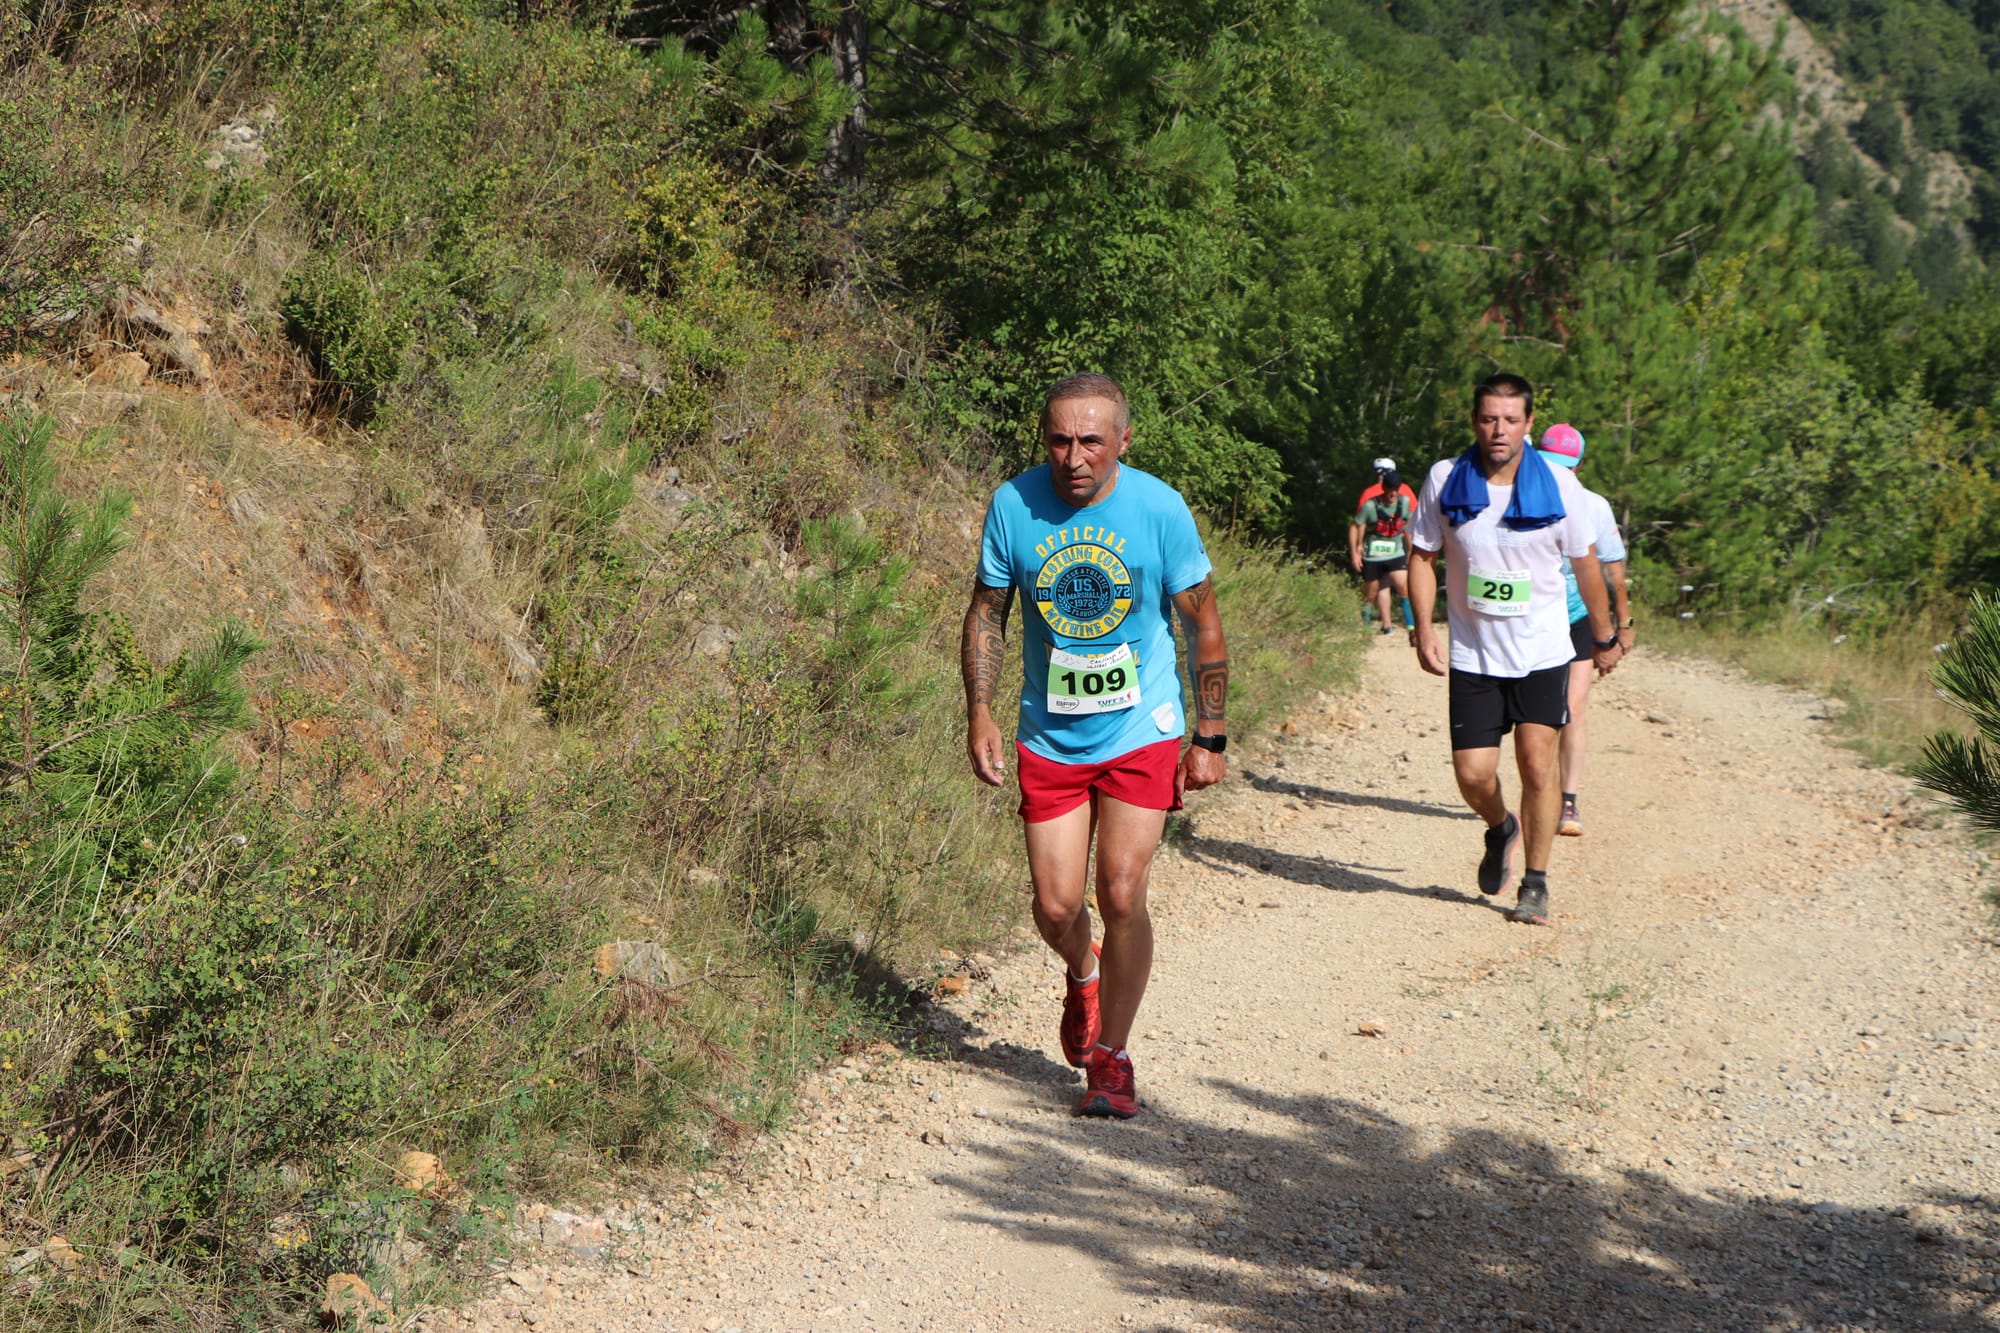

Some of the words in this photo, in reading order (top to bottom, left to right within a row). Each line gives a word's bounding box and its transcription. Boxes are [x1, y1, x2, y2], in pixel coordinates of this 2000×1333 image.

[1035, 526, 1126, 558] OFFICIAL
[1039, 546, 1093, 585] CLOTHING
[1057, 569, 1080, 593] COLLEGE
[1080, 568, 1109, 590] ATHLETIC
[1072, 578, 1095, 592] US.
[1038, 589, 1049, 600] 19
[1067, 591, 1100, 599] MARSHALL
[1116, 586, 1131, 597] 72
[1482, 581, 1514, 601] 29
[1074, 598, 1093, 607] 1972
[1044, 608, 1103, 636] MACHINE
[1104, 606, 1126, 628] OIL
[1071, 608, 1098, 617] FLORIDA
[1061, 668, 1126, 695] 109
